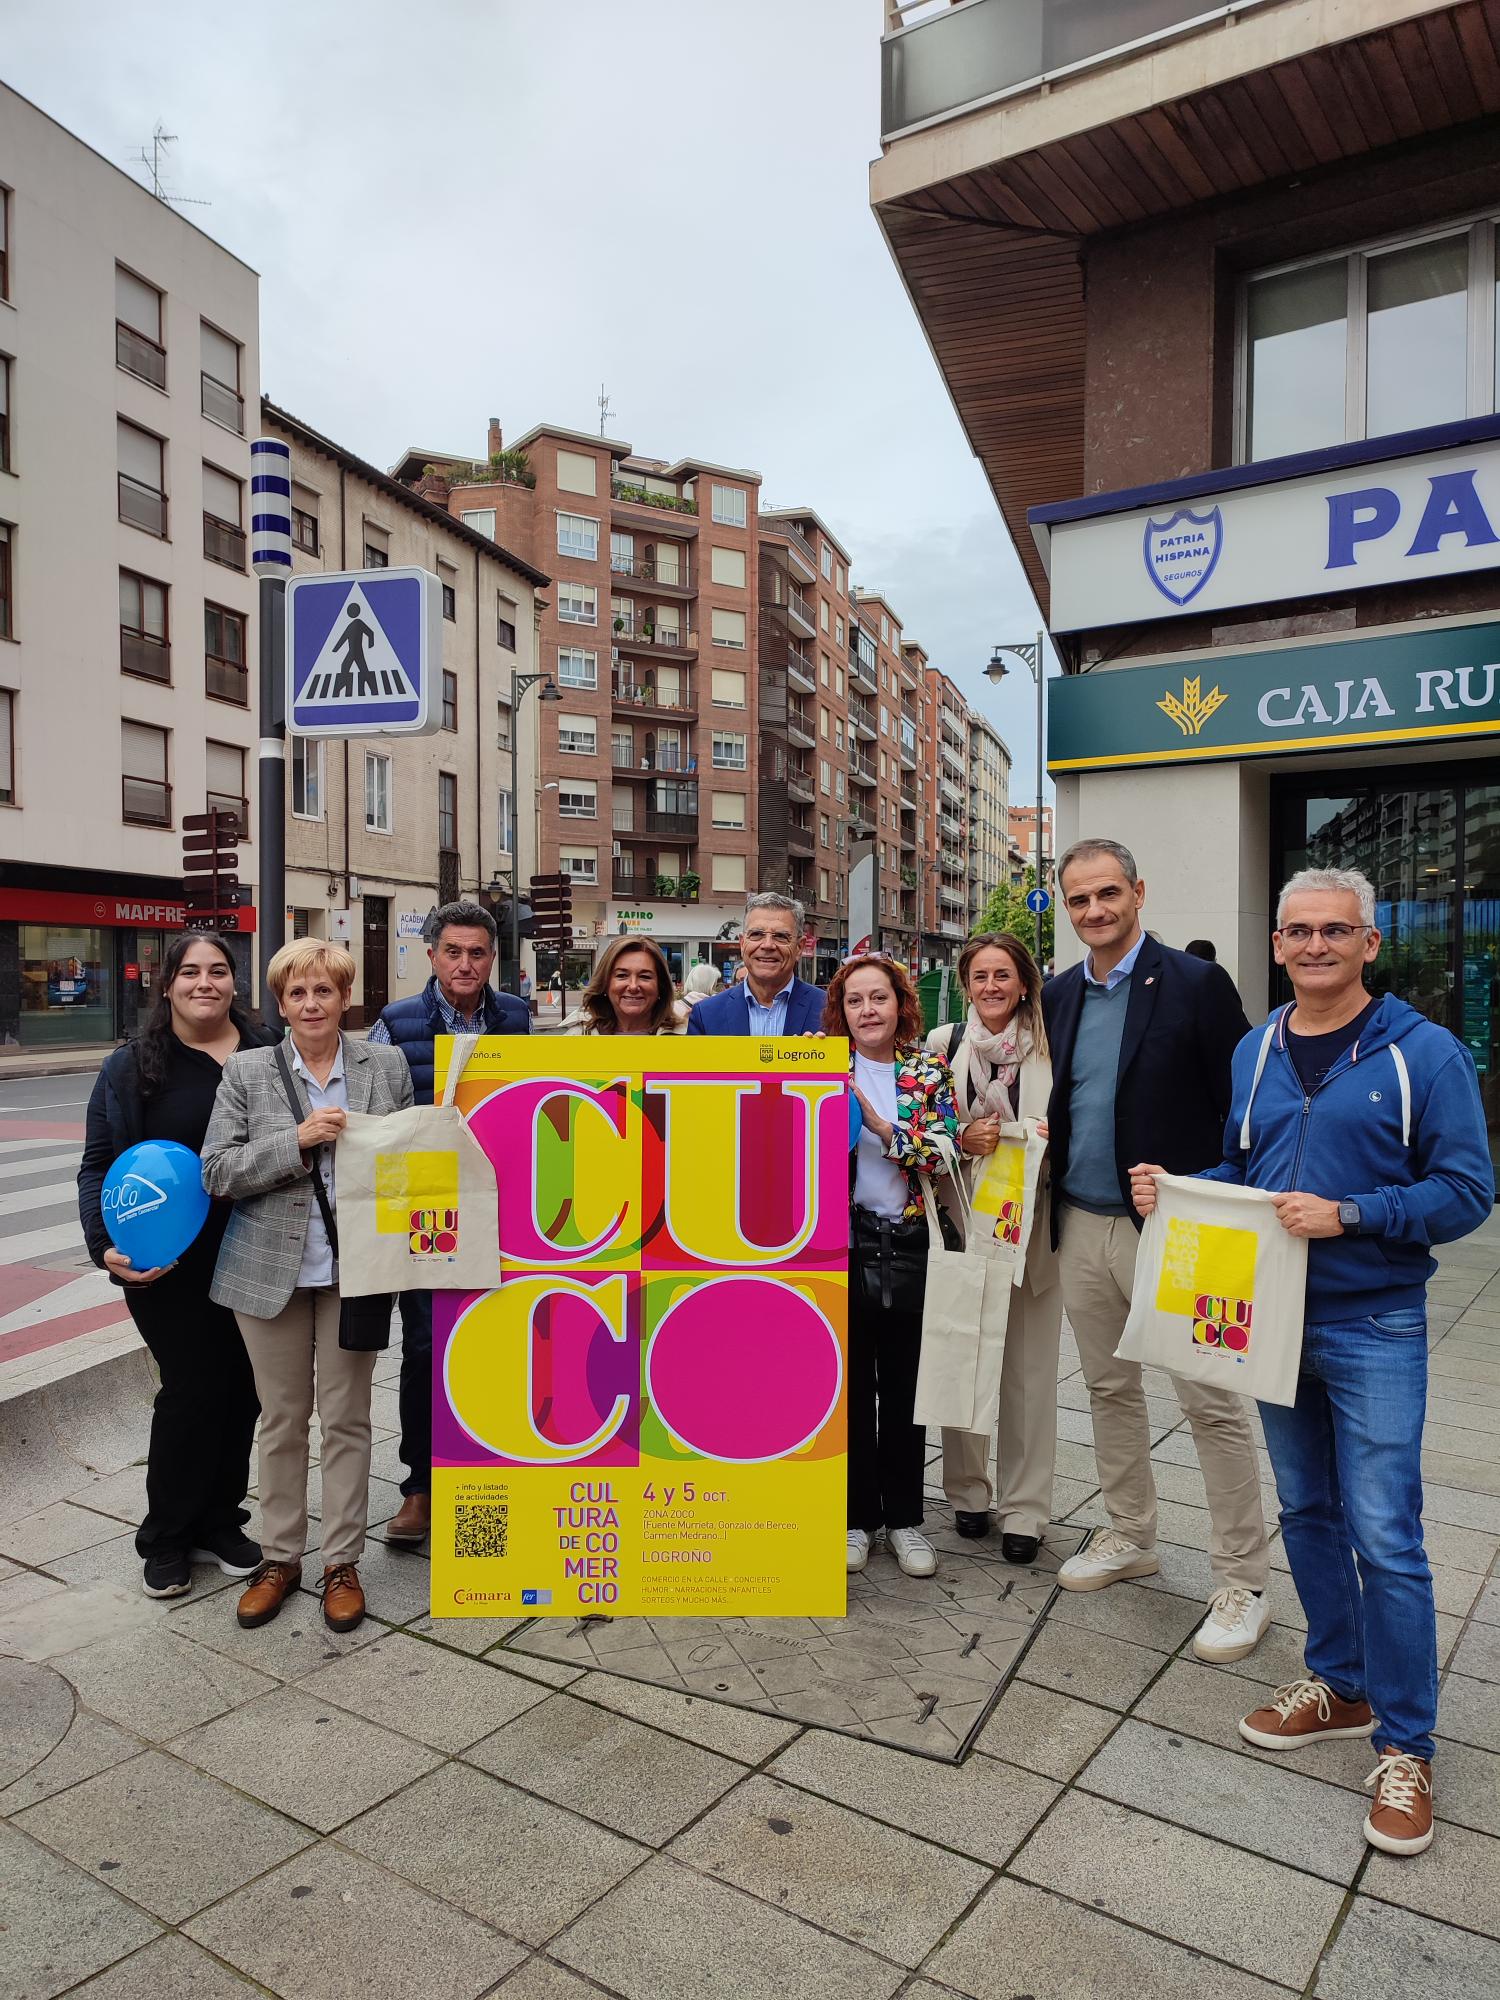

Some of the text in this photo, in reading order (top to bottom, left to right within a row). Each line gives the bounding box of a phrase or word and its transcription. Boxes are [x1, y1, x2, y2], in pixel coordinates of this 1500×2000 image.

[1160, 533, 1205, 547] PATRIA
[1155, 546, 1210, 563] HISPANA
[1163, 569, 1203, 582] SEGUROS
[1257, 677, 1396, 728] CAJA
[115, 903, 187, 923] MAPFRE
[400, 914, 426, 924] ACADEMI
[616, 910, 654, 920] ZAFIRO
[470, 1050, 502, 1059] roño.es
[777, 1049, 825, 1062] Logroño
[570, 1482, 619, 1503] CUL
[642, 1482, 730, 1507] 4 y 5 OCT.
[552, 1507, 620, 1529] TURA
[643, 1510, 695, 1519] ZONA ZOCO
[718, 1520, 752, 1530] Gonzalo
[753, 1520, 765, 1530] de
[766, 1520, 799, 1531] Berceo,
[559, 1532, 619, 1553] DE CO
[643, 1531, 678, 1540] Carmen
[642, 1548, 713, 1563] LOGROÑO
[564, 1557, 619, 1579] MER
[453, 1588, 512, 1604] Cámara
[578, 1582, 619, 1604] CIO
[728, 1586, 772, 1594] INFANTILES
[522, 1592, 536, 1603] fer
[641, 1596, 676, 1604] SORTEOS
[676, 1596, 681, 1604] Y
[682, 1596, 710, 1604] MUCHO
